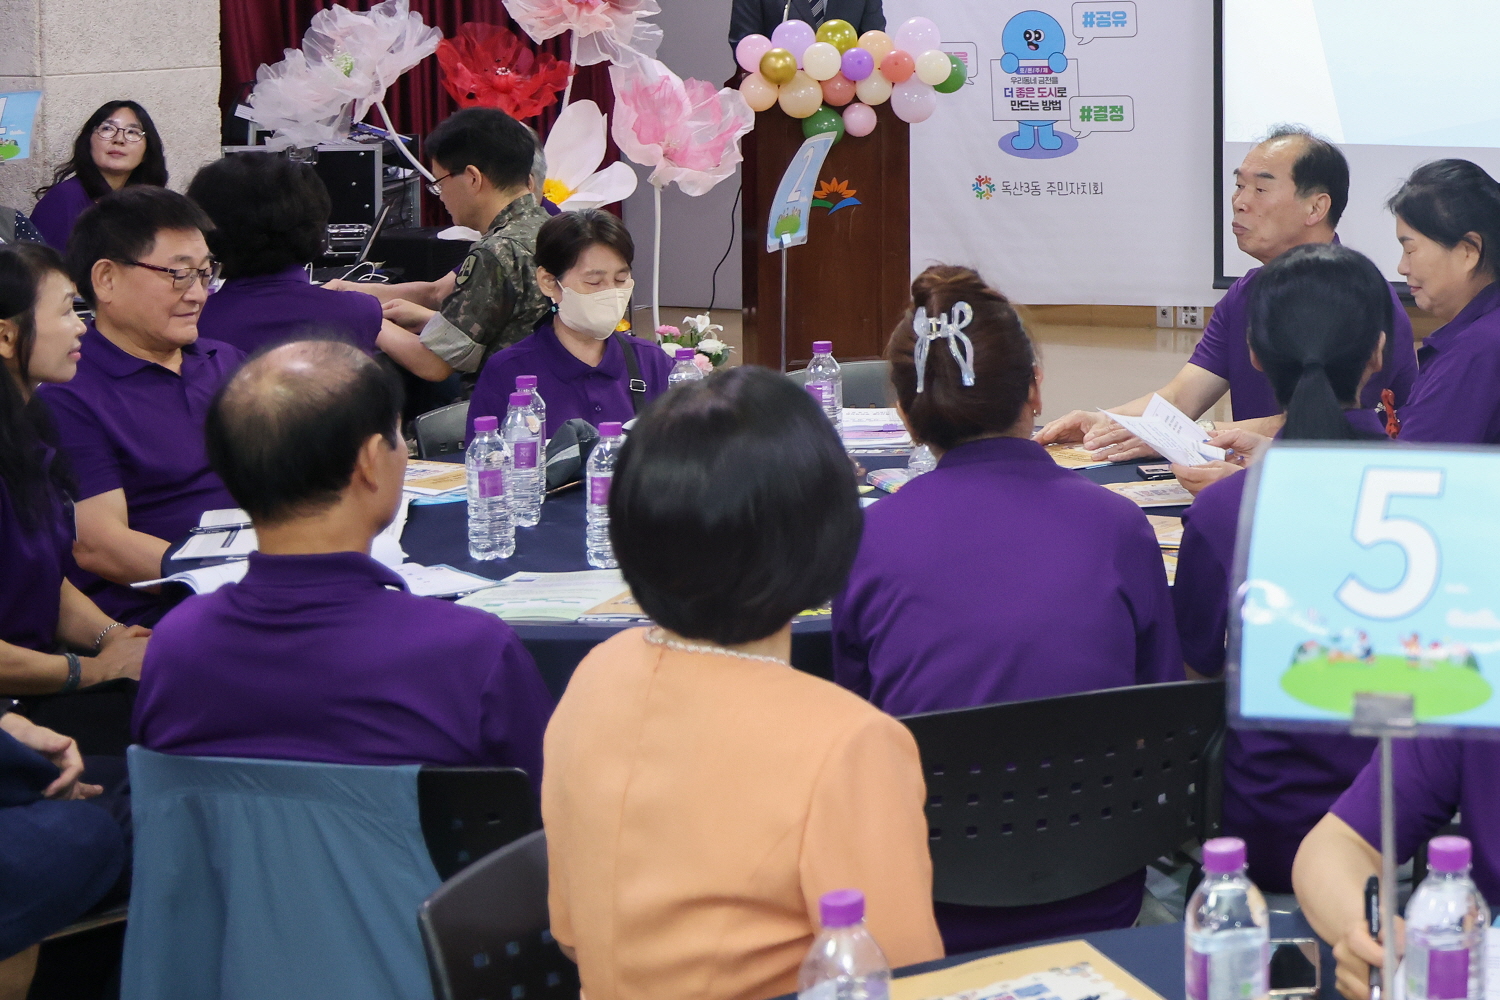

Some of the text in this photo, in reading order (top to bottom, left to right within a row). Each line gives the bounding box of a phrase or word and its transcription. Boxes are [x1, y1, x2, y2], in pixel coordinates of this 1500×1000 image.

[1081, 10, 1128, 28] #공유
[1010, 76, 1059, 85] 우리동네 금천을
[1003, 86, 1067, 98] 더 좋은 도시로
[1010, 99, 1062, 112] 만드는 방법
[1078, 104, 1125, 123] #결정
[1000, 180, 1104, 197] 독산3동 주민자치회
[1334, 464, 1446, 622] 5
